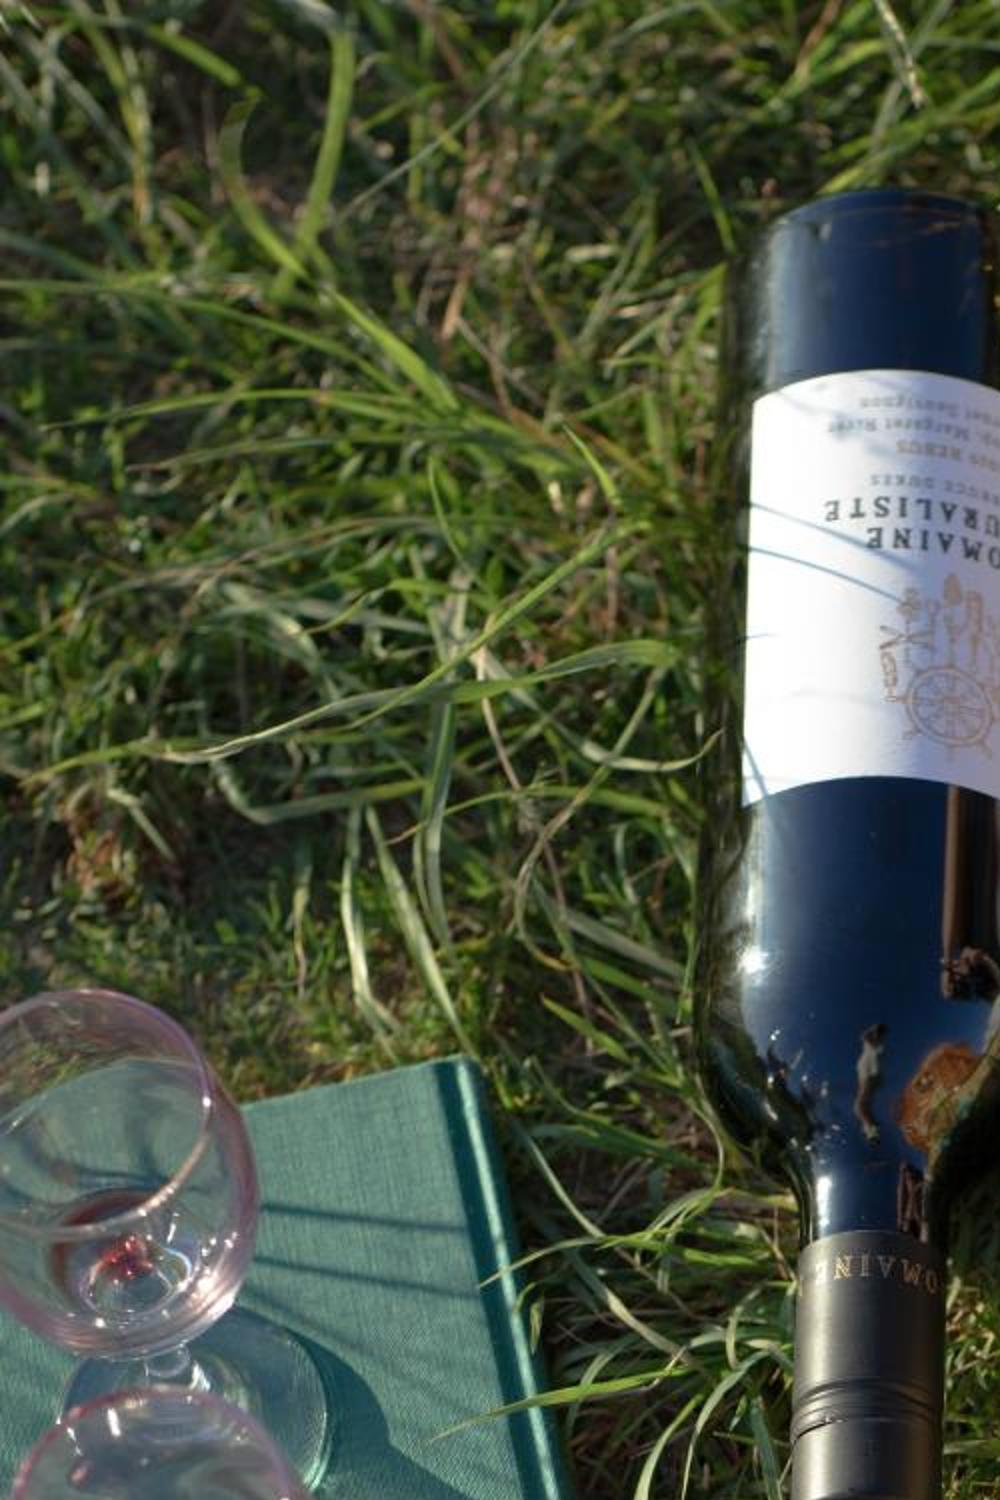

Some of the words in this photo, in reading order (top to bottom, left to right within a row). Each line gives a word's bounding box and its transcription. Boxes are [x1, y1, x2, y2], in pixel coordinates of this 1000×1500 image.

[860, 396, 959, 418] Sauvignon
[829, 417, 877, 434] River
[885, 416, 970, 441] Margaret
[871, 474, 936, 489] DUKES
[815, 1254, 938, 1294] OMAINE
